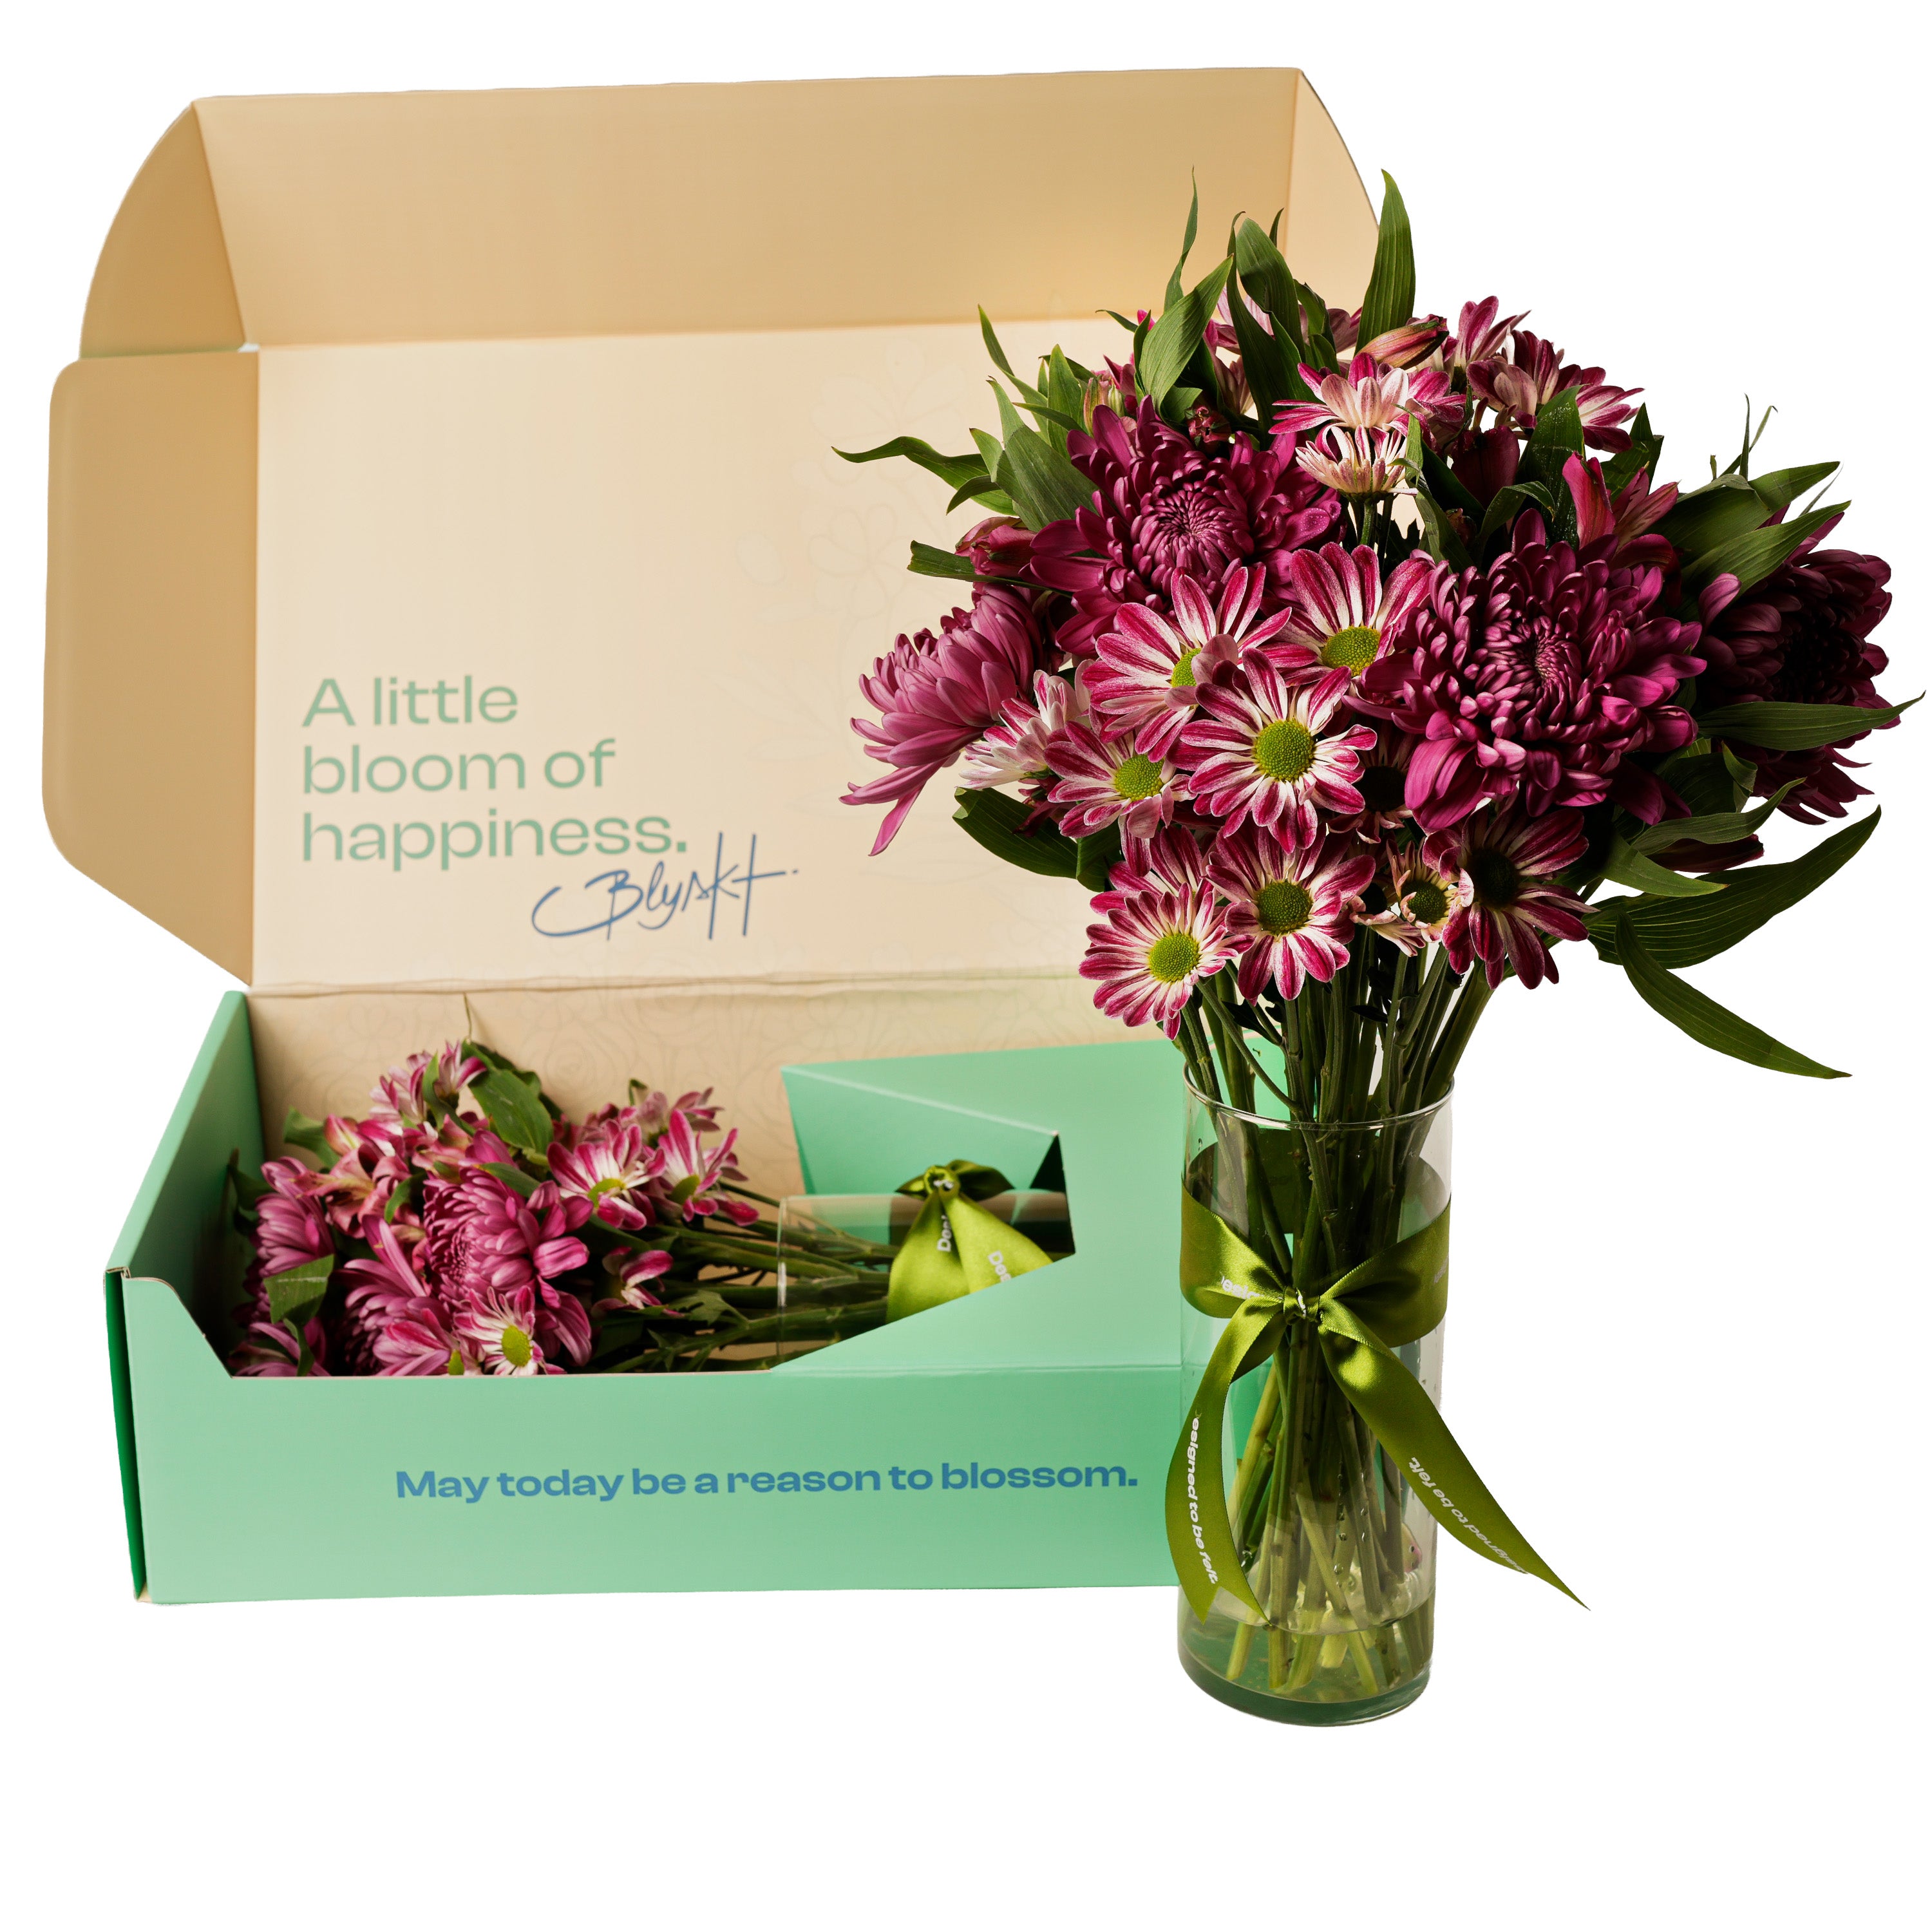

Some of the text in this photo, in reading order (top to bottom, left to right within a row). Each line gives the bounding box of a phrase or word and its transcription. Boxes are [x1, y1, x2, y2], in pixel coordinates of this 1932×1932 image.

[302, 676, 518, 728] A little
[304, 738, 616, 795] bloom of
[303, 808, 688, 872] happiness.
[395, 1463, 1139, 1504] May today be a reason to blossom.
[1408, 1457, 1437, 1488] felt.
[1189, 1501, 1198, 1523] to
[1432, 1488, 1454, 1508] be
[1450, 1508, 1468, 1524] to
[1192, 1526, 1205, 1549] be
[1199, 1551, 1218, 1584] felt.
